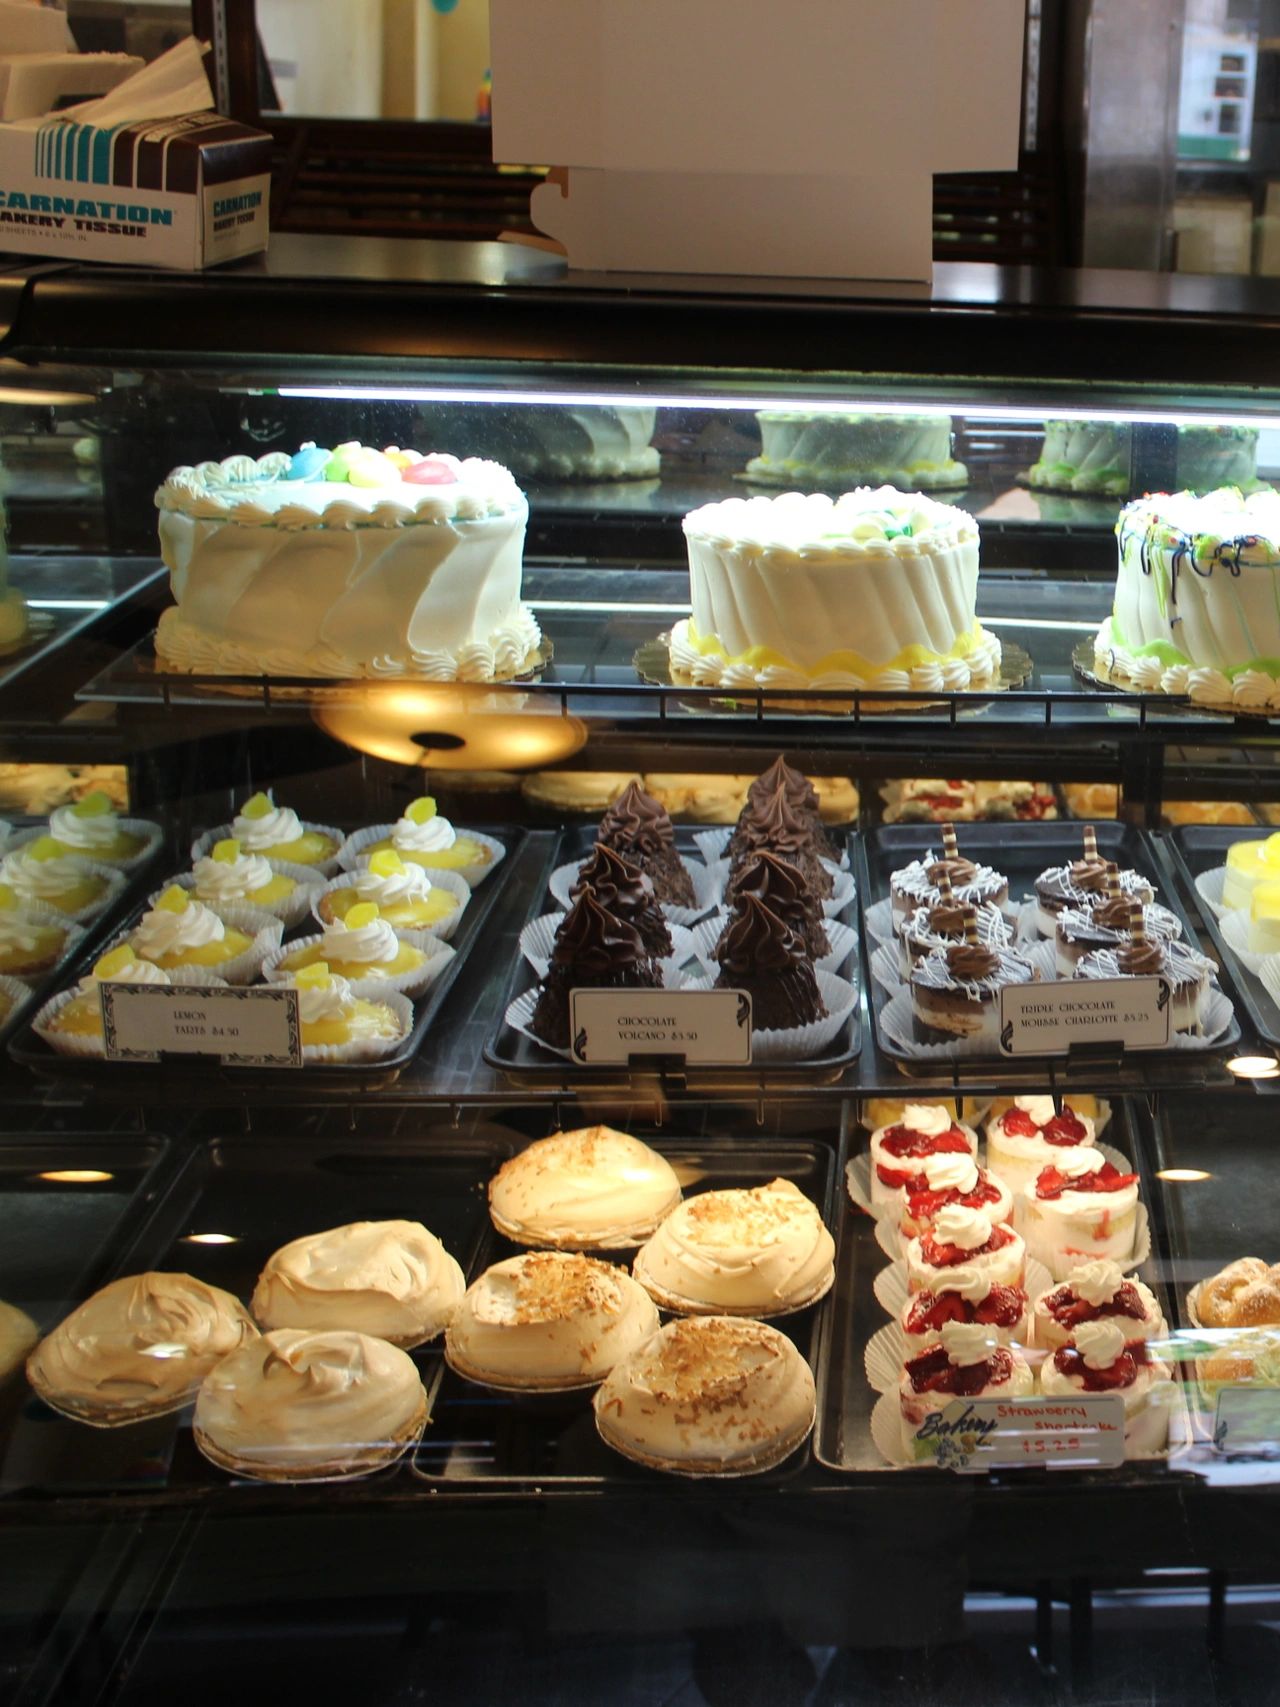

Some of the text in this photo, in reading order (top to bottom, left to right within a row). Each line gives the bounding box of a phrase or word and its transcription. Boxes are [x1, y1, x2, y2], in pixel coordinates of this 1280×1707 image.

[213, 190, 262, 218] CARNATION
[0, 210, 147, 238] AKERY TISSUE
[1020, 1001, 1115, 1014] TRIPLE CHOCOLATE
[174, 1011, 206, 1020] LEMON
[617, 1016, 677, 1026] CHOCOLATE
[1021, 1017, 1060, 1028] MOUSSE
[1065, 1014, 1119, 1026] CHARLOTTE
[175, 1025, 206, 1035] TARTS
[618, 1031, 666, 1041] VOLCANO
[996, 1404, 1088, 1419] Strawberry
[916, 1404, 999, 1445] Bakery
